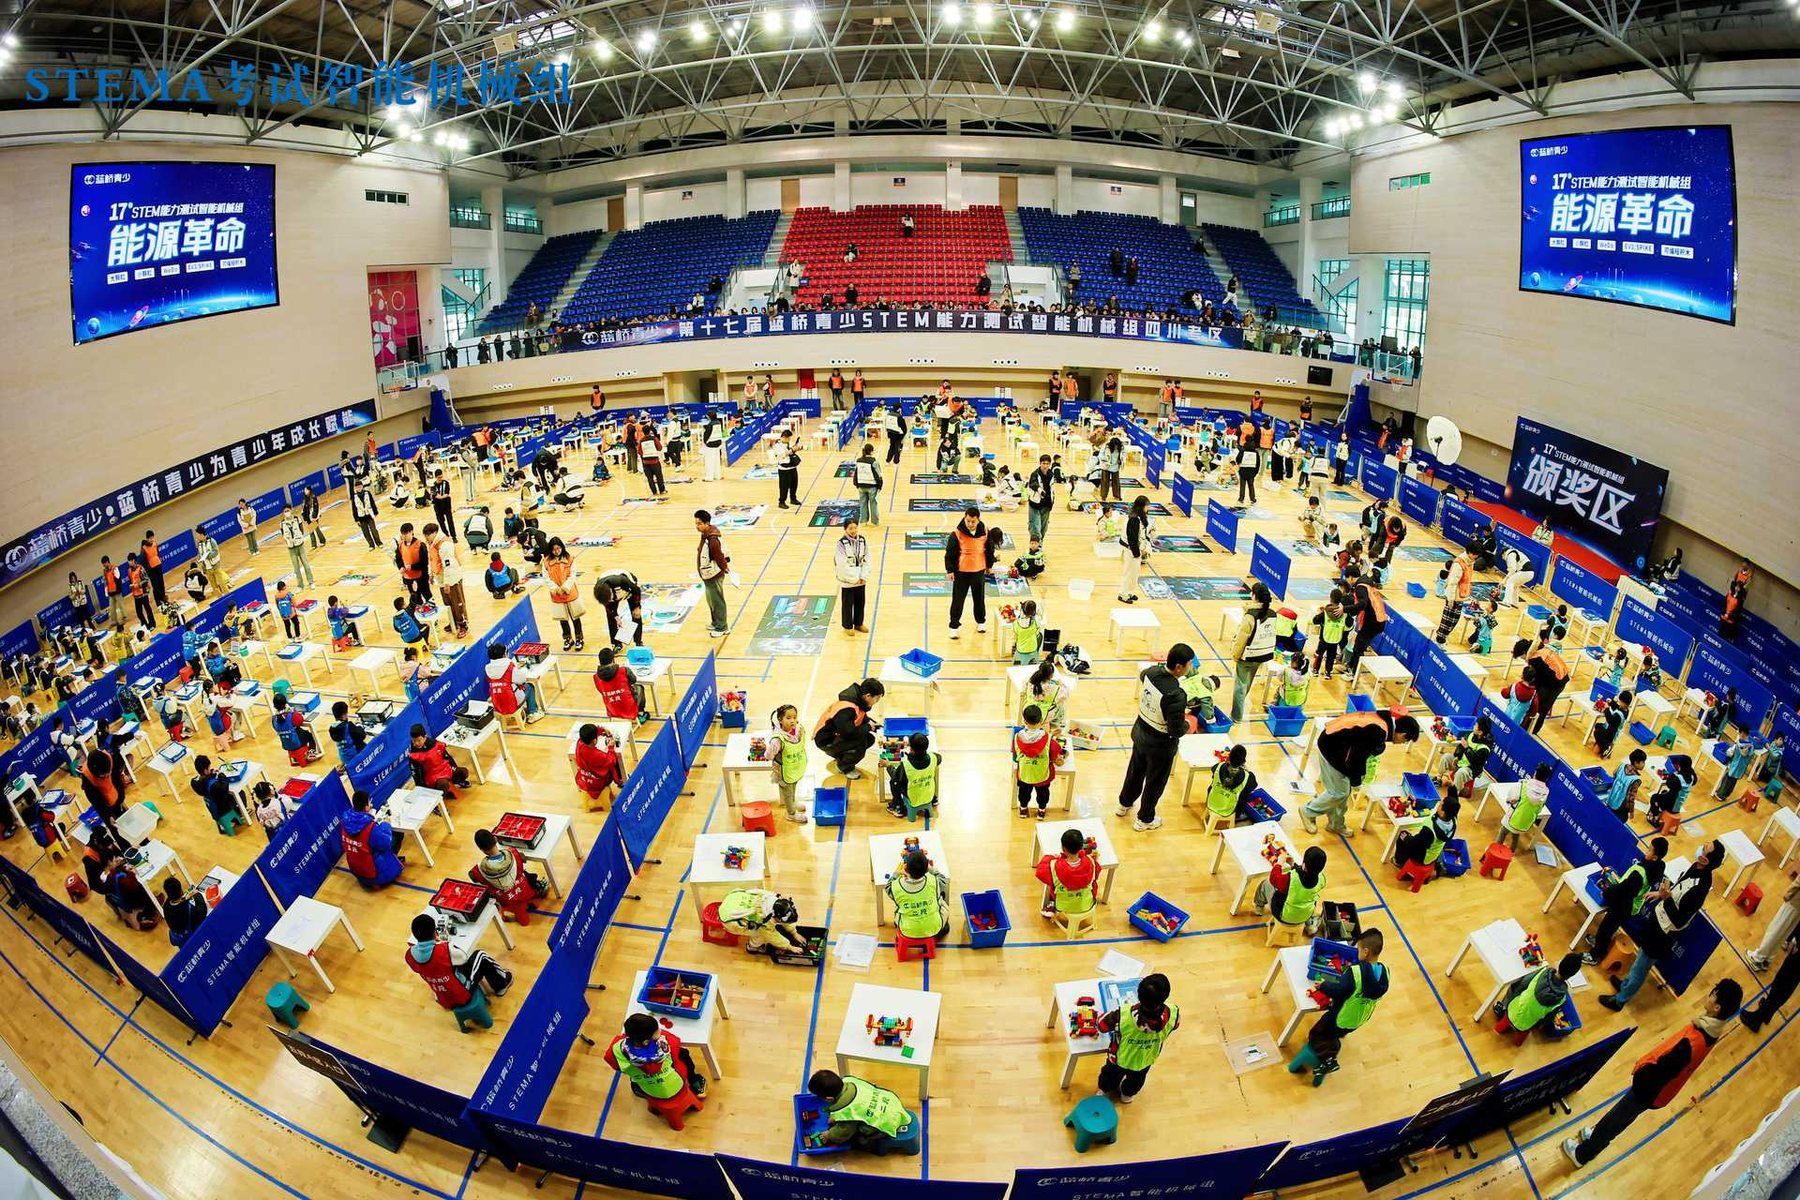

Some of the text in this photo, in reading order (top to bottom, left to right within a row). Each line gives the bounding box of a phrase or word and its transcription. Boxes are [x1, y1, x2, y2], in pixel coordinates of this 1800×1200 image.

[107, 216, 246, 267] 能源革命
[1550, 192, 1695, 239] 能源革命
[600, 326, 659, 346] 蓝桥青少
[1522, 454, 1637, 536] 颁奖区
[28, 505, 108, 559] 蓝桥青少
[206, 918, 261, 986] STEMA智能机械组
